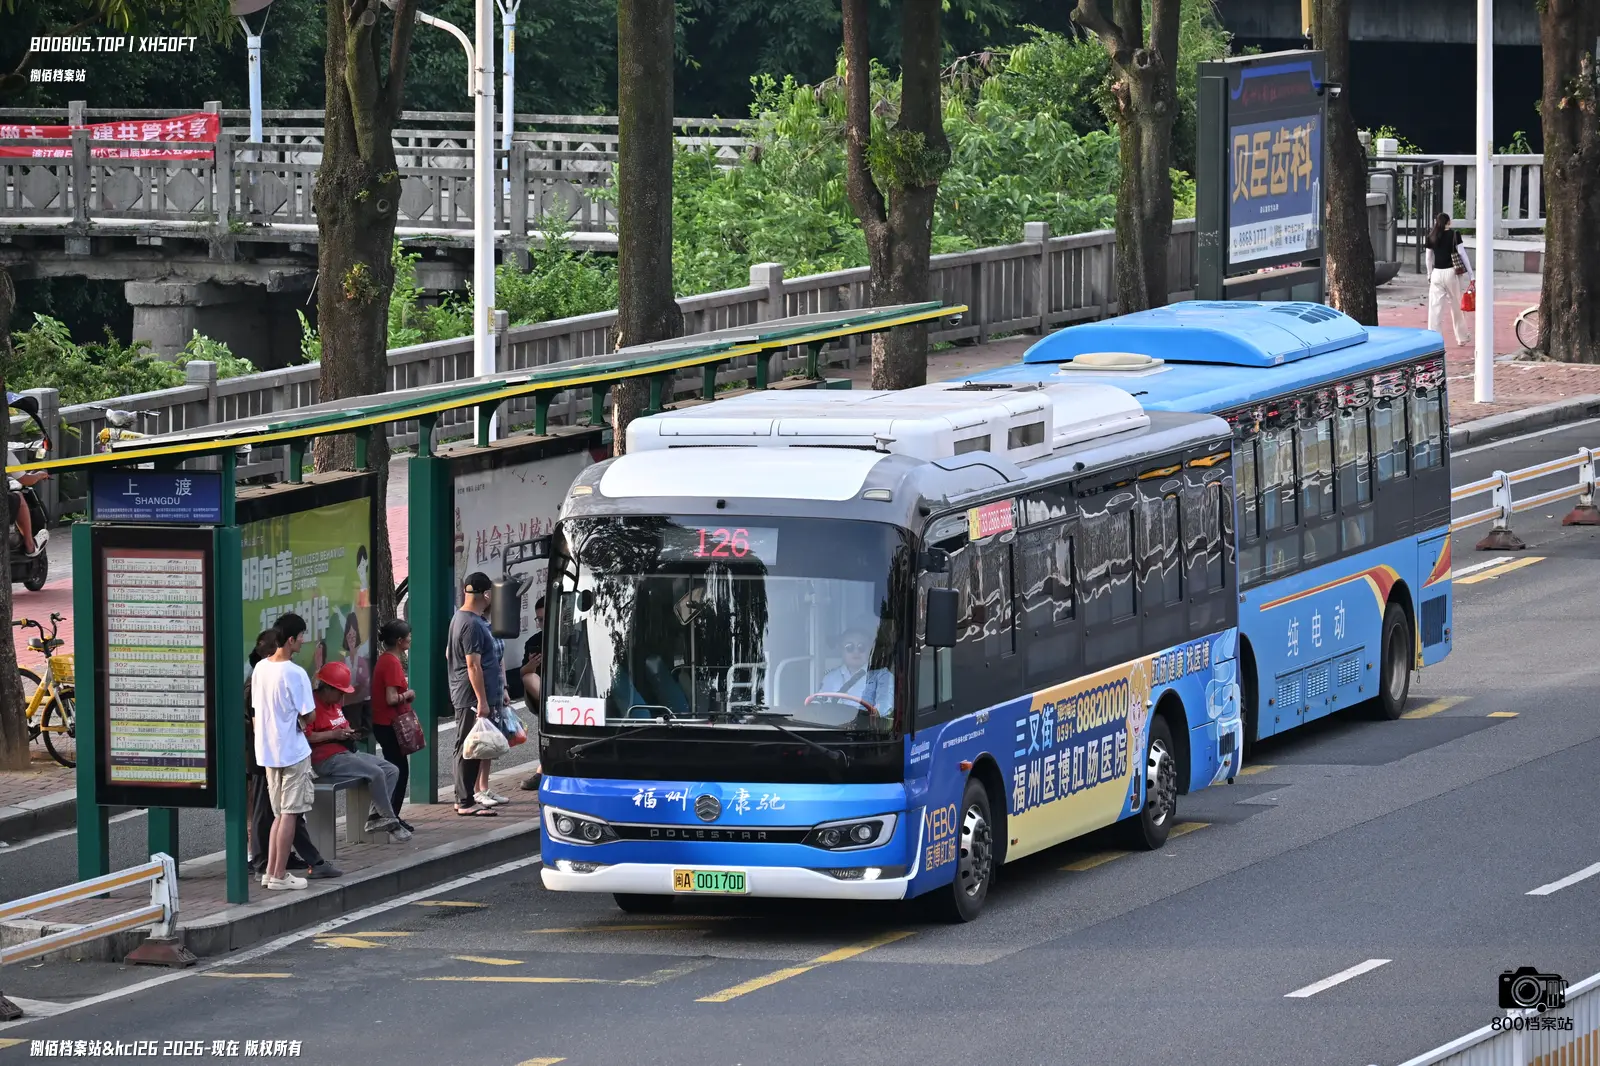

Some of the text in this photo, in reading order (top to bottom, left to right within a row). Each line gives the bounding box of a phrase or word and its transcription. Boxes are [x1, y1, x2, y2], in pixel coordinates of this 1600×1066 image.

[1232, 122, 1313, 203] 贝臣齿科
[122, 478, 193, 496] 上渡
[135, 497, 181, 505] SHANGDU
[693, 528, 750, 558] 126
[1287, 600, 1345, 657] 纯电动
[557, 707, 596, 726] 126
[1076, 682, 1128, 734] 88820000
[1014, 705, 1054, 758] 三叉街
[1013, 728, 1127, 813] 福州医博肛肠医院
[632, 787, 689, 811] 福州
[925, 803, 957, 843] YEBO
[925, 836, 956, 871] 医博肛肠
